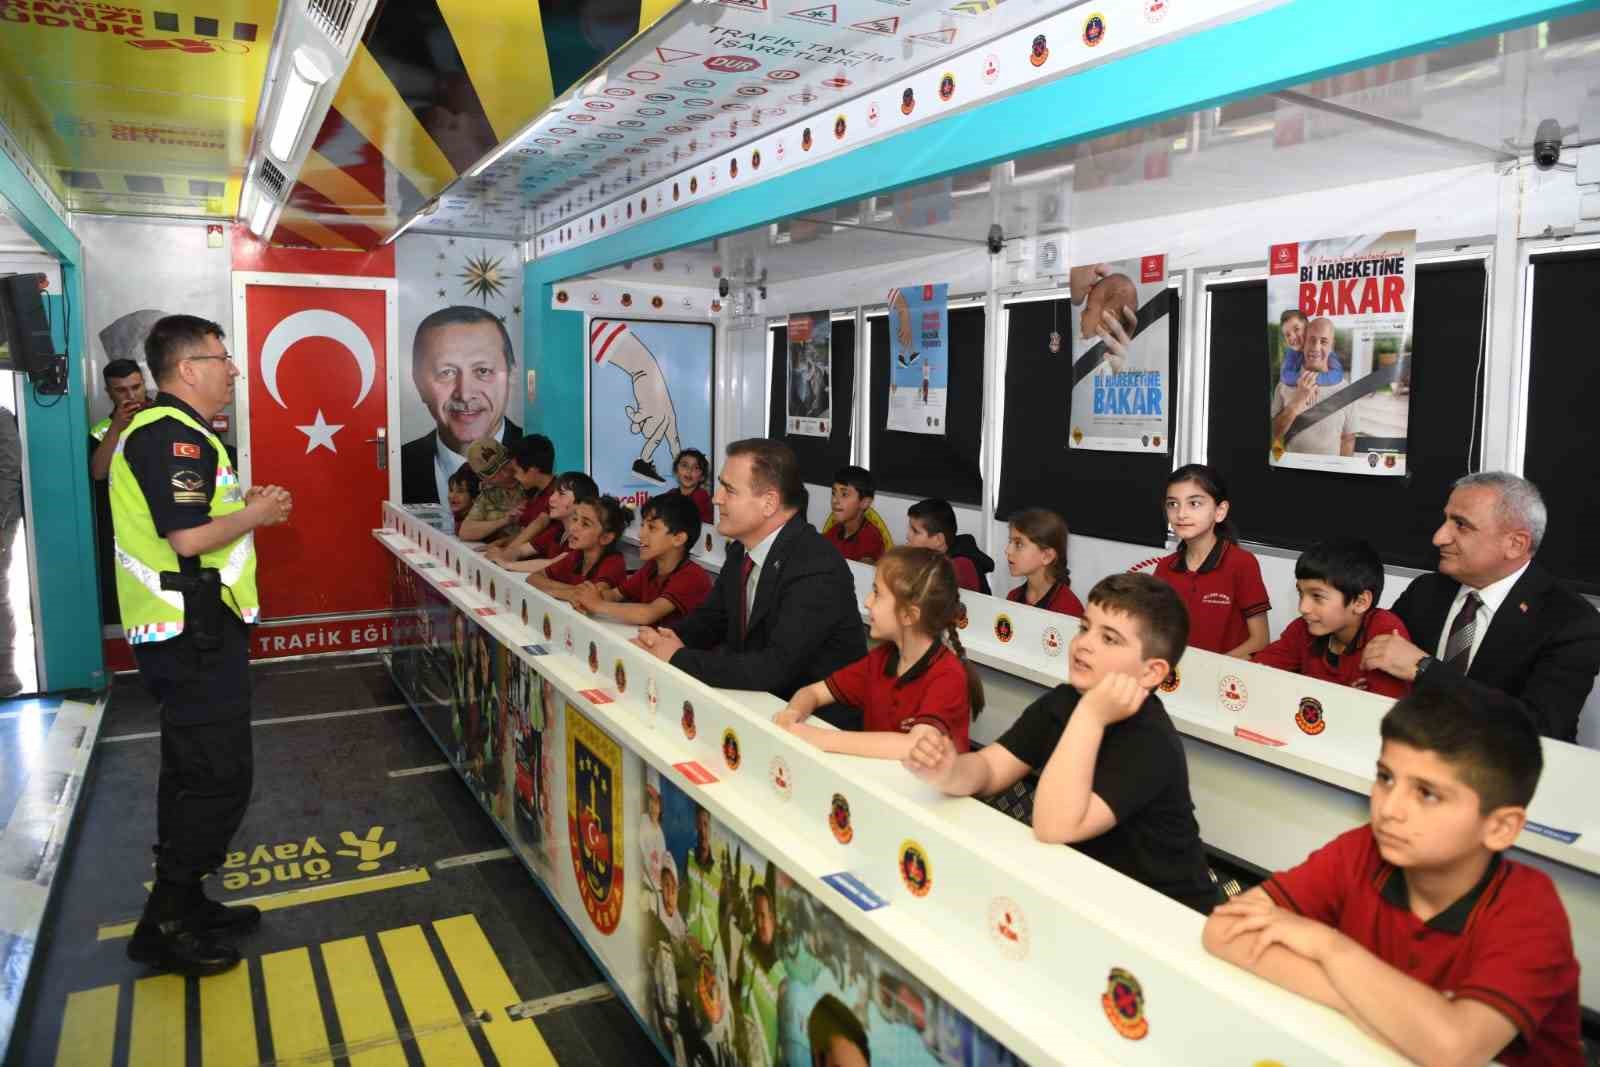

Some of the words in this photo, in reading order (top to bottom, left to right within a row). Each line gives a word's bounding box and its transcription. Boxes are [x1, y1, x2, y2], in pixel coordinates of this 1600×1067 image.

[708, 26, 801, 47] TRAFİK
[713, 57, 754, 70] DUR
[1317, 257, 1405, 281] HAREKETİNE
[1299, 275, 1406, 317] BAKAR
[1093, 387, 1163, 415] BAKAR
[259, 628, 342, 652] TRAFİK
[350, 623, 393, 643] EĞİ
[223, 835, 328, 868] yaya
[223, 858, 332, 890] önce
